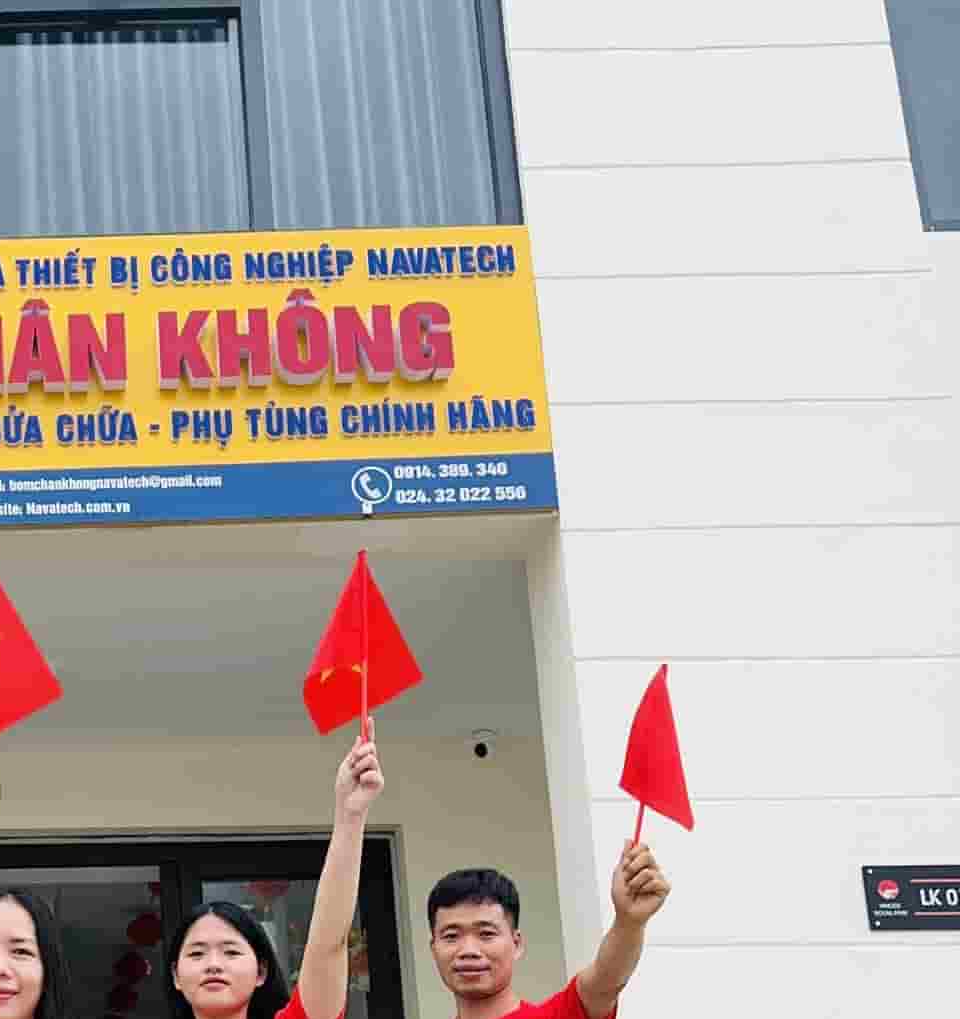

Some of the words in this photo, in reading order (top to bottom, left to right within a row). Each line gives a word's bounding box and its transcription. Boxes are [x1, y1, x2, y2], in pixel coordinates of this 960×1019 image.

[15, 247, 97, 290] THIẾT
[110, 255, 139, 294] BỊ
[150, 247, 233, 287] CÔNG
[244, 243, 354, 286] NGHIỆP
[367, 244, 516, 279] NAVATECH
[157, 288, 456, 390] KHÔNG
[56, 404, 139, 446] CHỮA
[171, 409, 233, 450] PHỤ
[245, 400, 329, 441] TÙNG
[341, 397, 436, 437] CHÍNH
[447, 394, 538, 432] HÃNG
[434, 488, 456, 503] 32
[459, 486, 491, 502] 022
[919, 887, 943, 906] LK
[945, 888, 960, 906] 0
